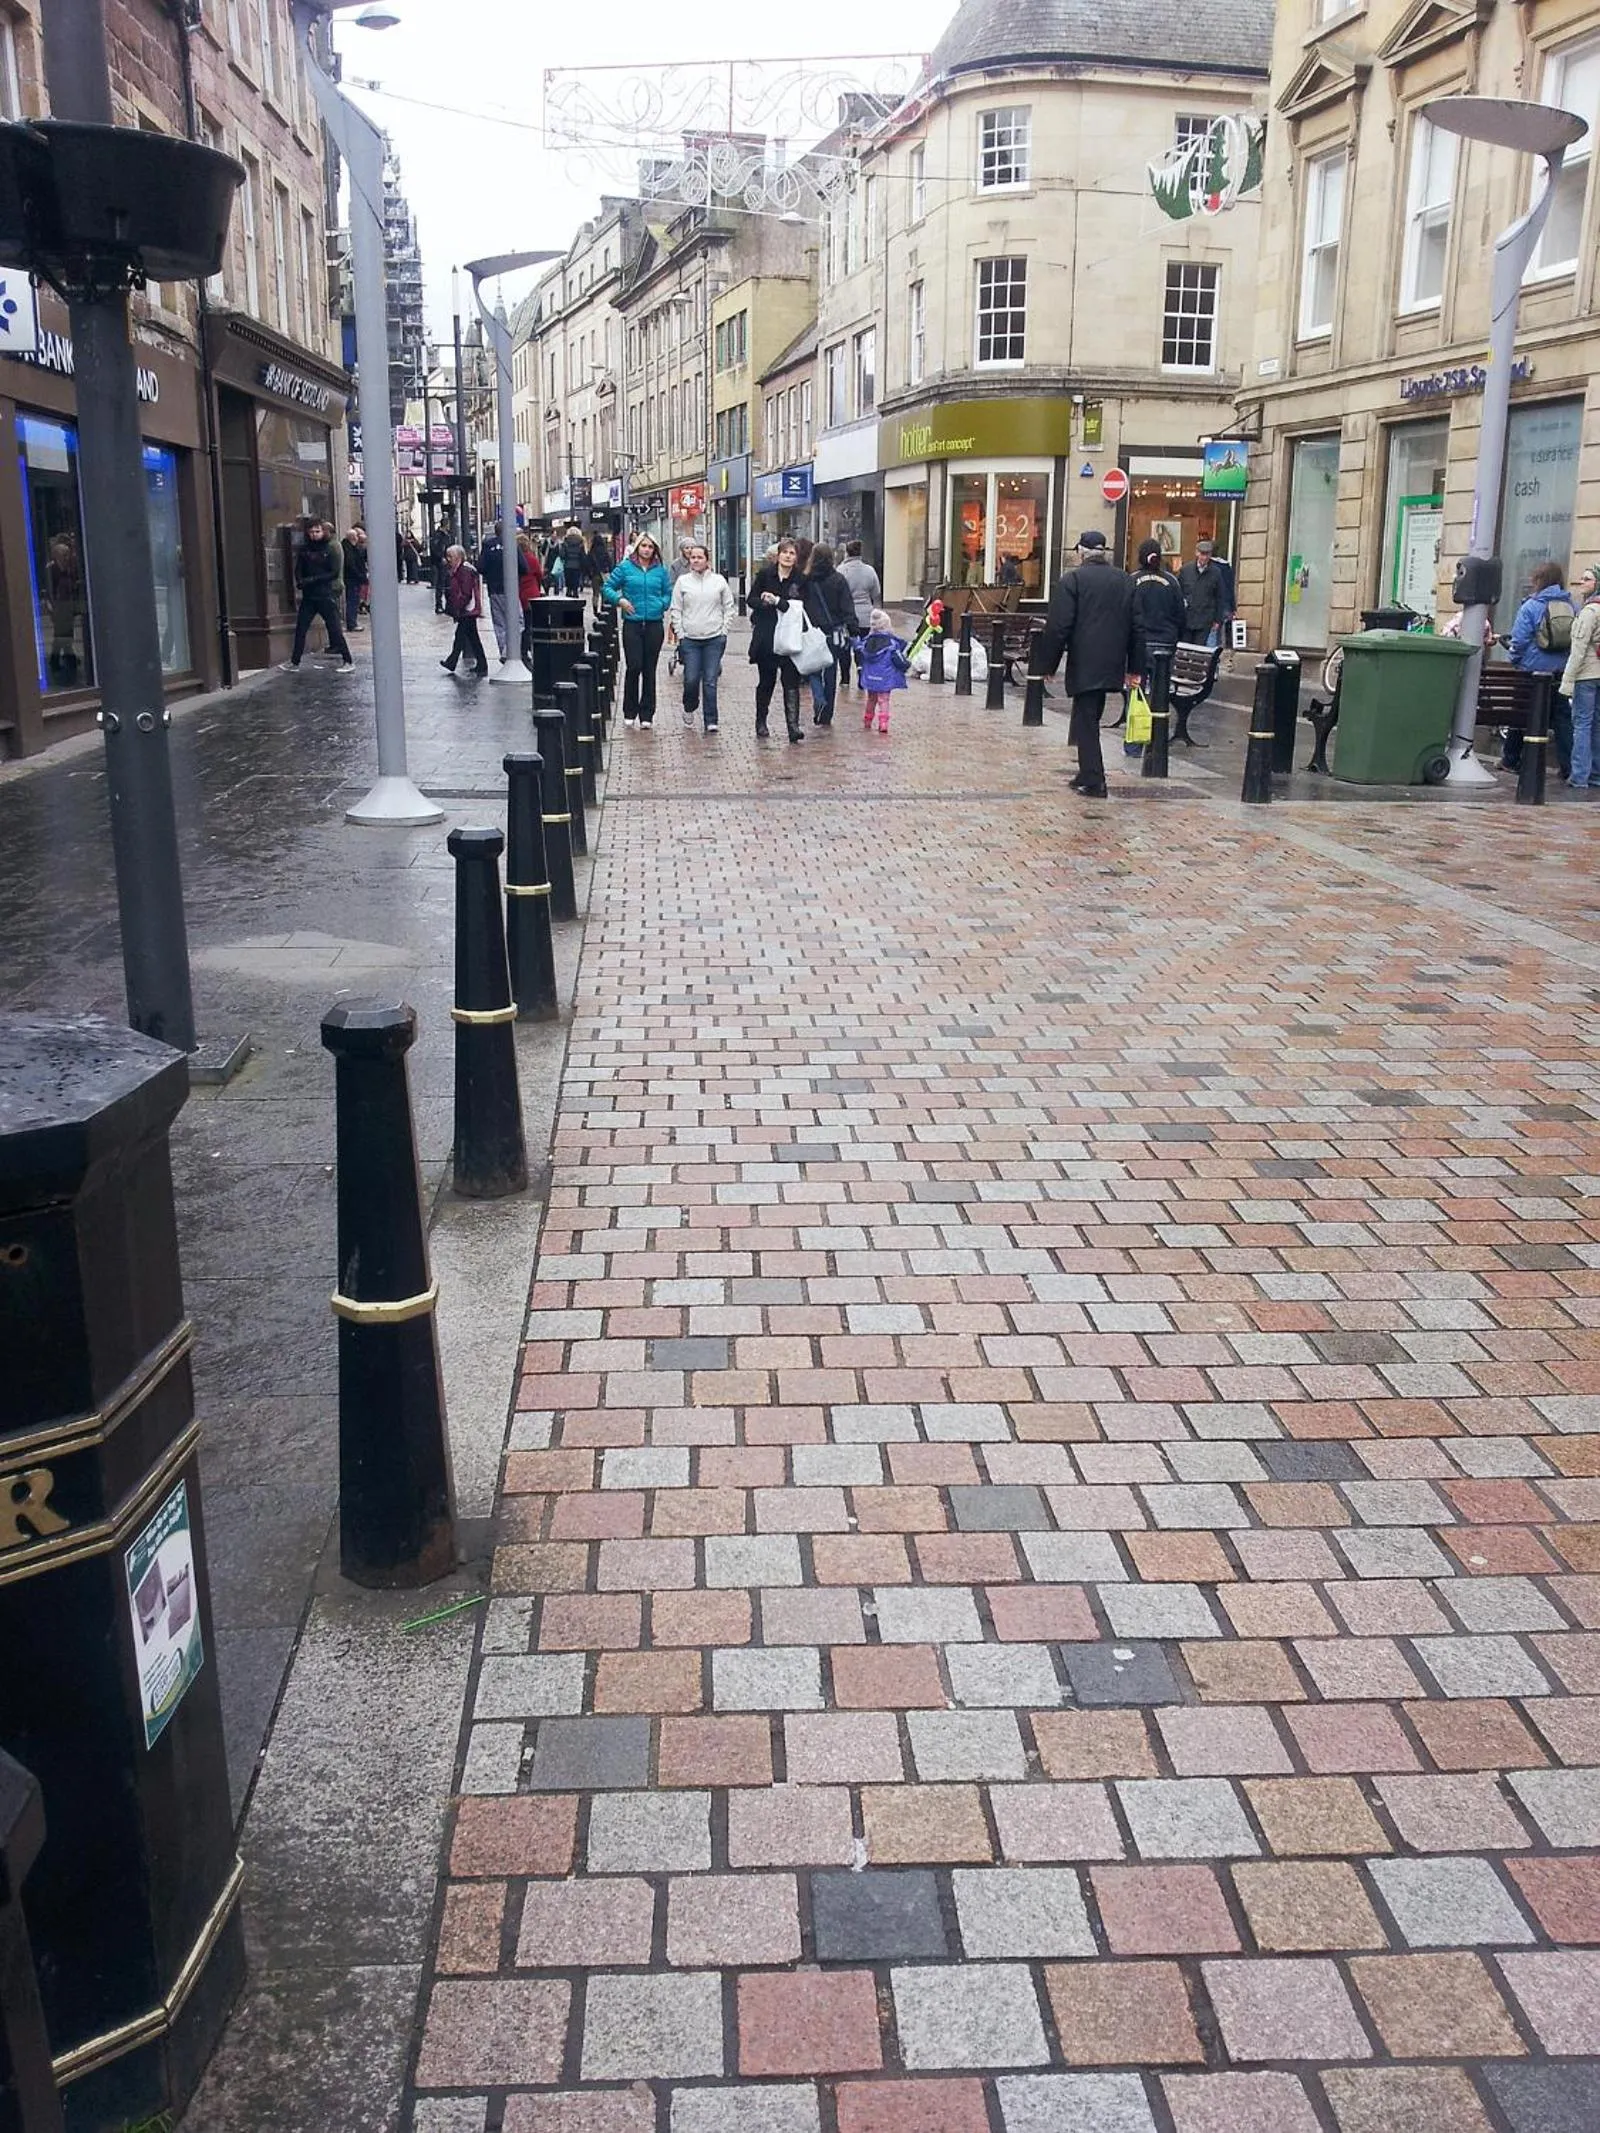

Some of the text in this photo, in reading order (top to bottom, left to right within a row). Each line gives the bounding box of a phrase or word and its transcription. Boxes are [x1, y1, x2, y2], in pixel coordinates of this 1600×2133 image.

[273, 367, 295, 396] BANK
[302, 381, 330, 412] SCOTLAND
[1443, 368, 1467, 391] TSB
[901, 422, 932, 458] hotter
[1514, 477, 1540, 497] cash
[1015, 514, 1029, 538] 2
